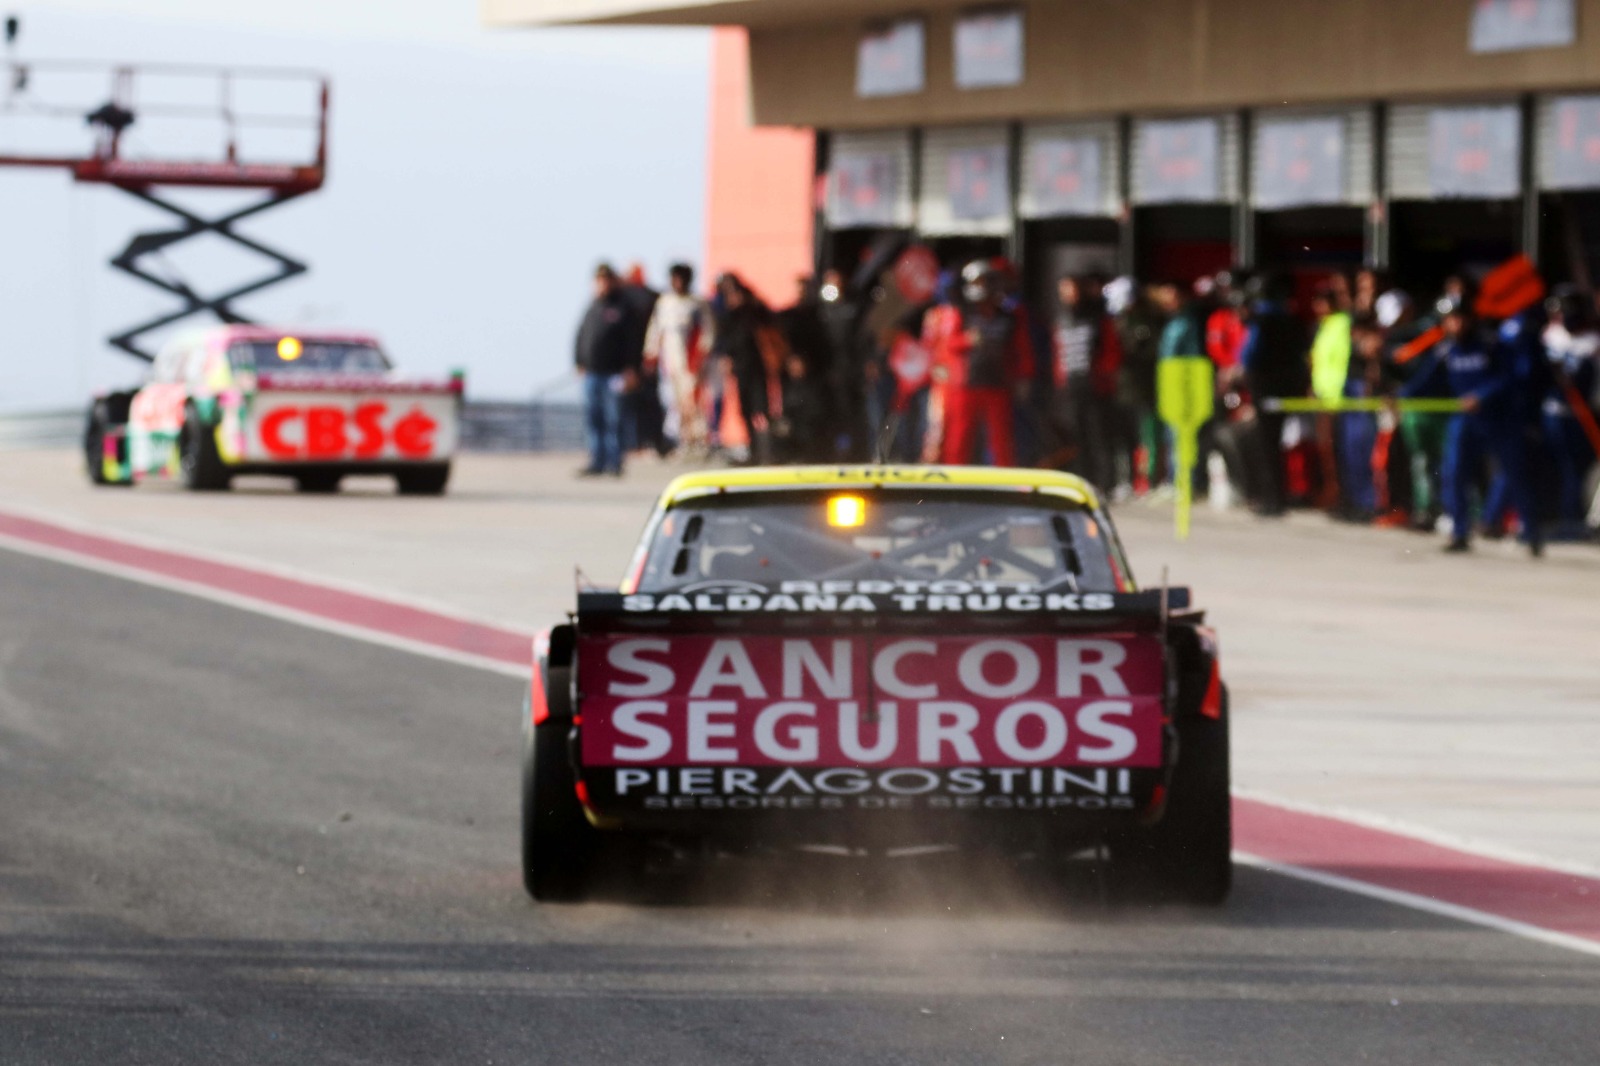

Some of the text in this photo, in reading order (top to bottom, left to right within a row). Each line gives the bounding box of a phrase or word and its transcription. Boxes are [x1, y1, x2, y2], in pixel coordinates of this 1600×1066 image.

[622, 593, 1115, 611] SALDANA TRUCKS
[606, 638, 1131, 699] SANCOR
[610, 700, 1138, 763] SEGUROS
[615, 768, 1131, 795] PIERAGOSTINI
